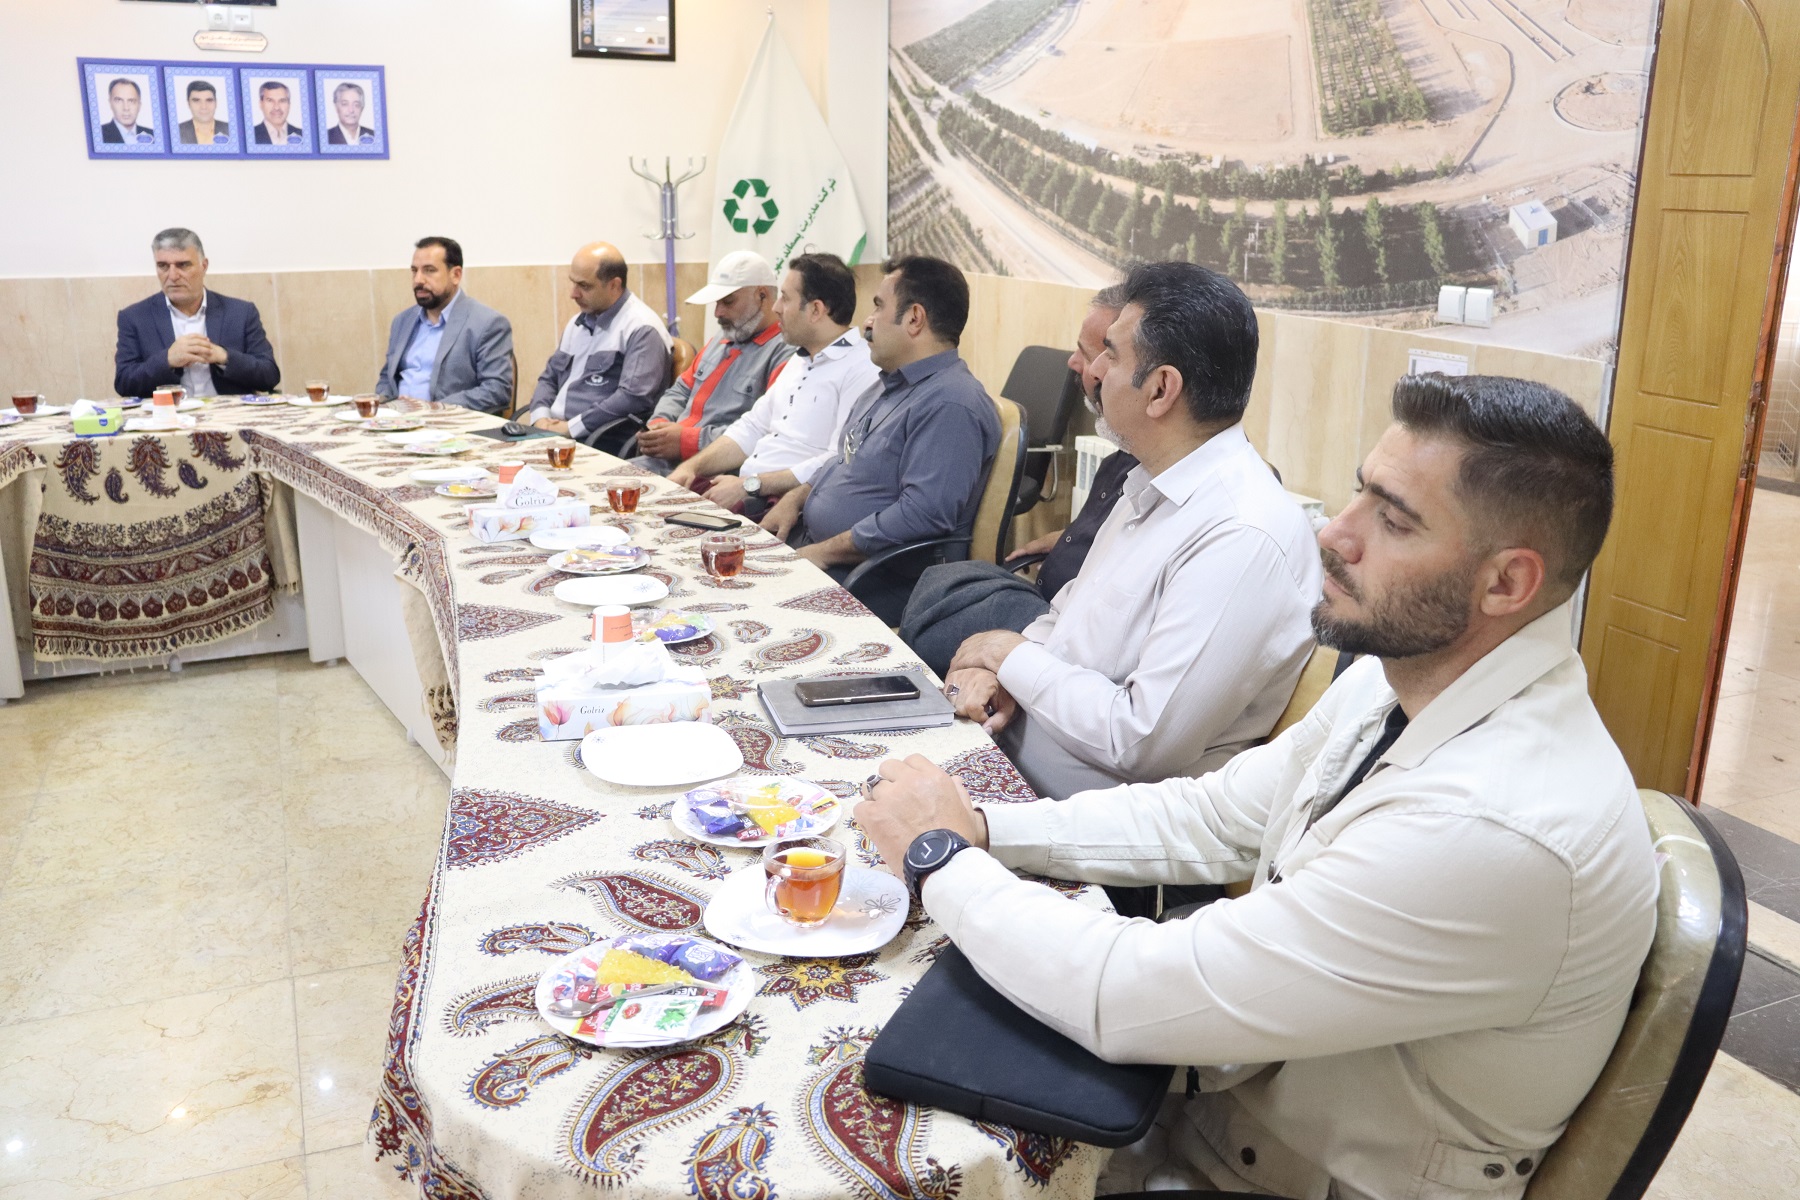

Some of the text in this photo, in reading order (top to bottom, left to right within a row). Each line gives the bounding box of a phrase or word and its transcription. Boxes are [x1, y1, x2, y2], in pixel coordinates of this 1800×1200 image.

[583, 17, 592, 34] ISO
[820, 178, 836, 203] شرکت
[799, 203, 820, 232] مدیریت
[783, 232, 805, 258] پسماند
[580, 705, 605, 714] Golriz
